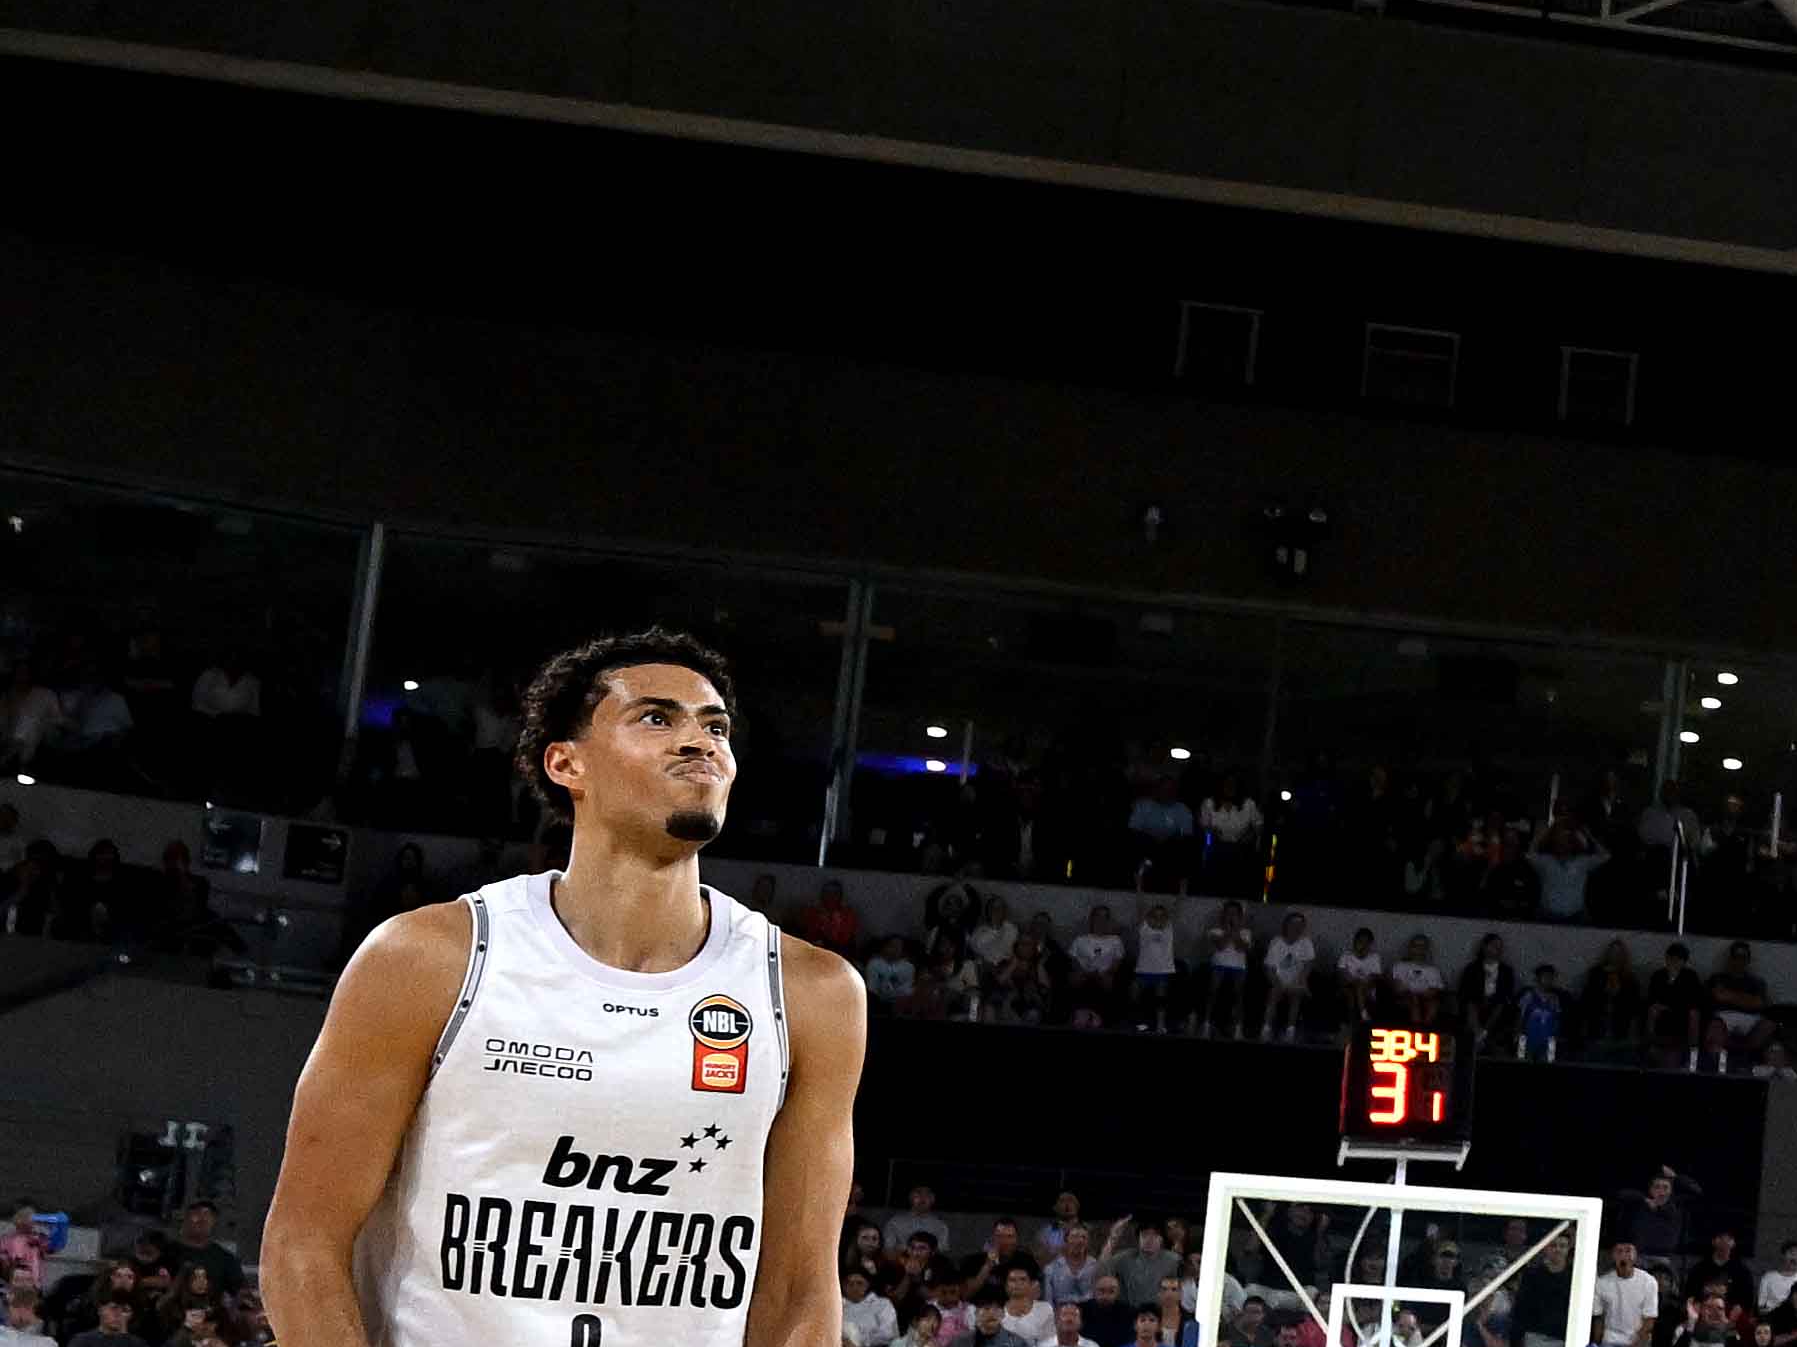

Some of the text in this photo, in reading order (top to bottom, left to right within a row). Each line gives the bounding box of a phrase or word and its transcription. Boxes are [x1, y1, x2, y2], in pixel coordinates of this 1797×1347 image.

[603, 1003, 659, 1018] OPTUS
[702, 1010, 739, 1034] NBL
[486, 1038, 593, 1063] OMODA
[484, 1058, 593, 1082] JAECOO
[543, 1136, 677, 1196] bnz
[440, 1193, 755, 1310] BREAKERS
